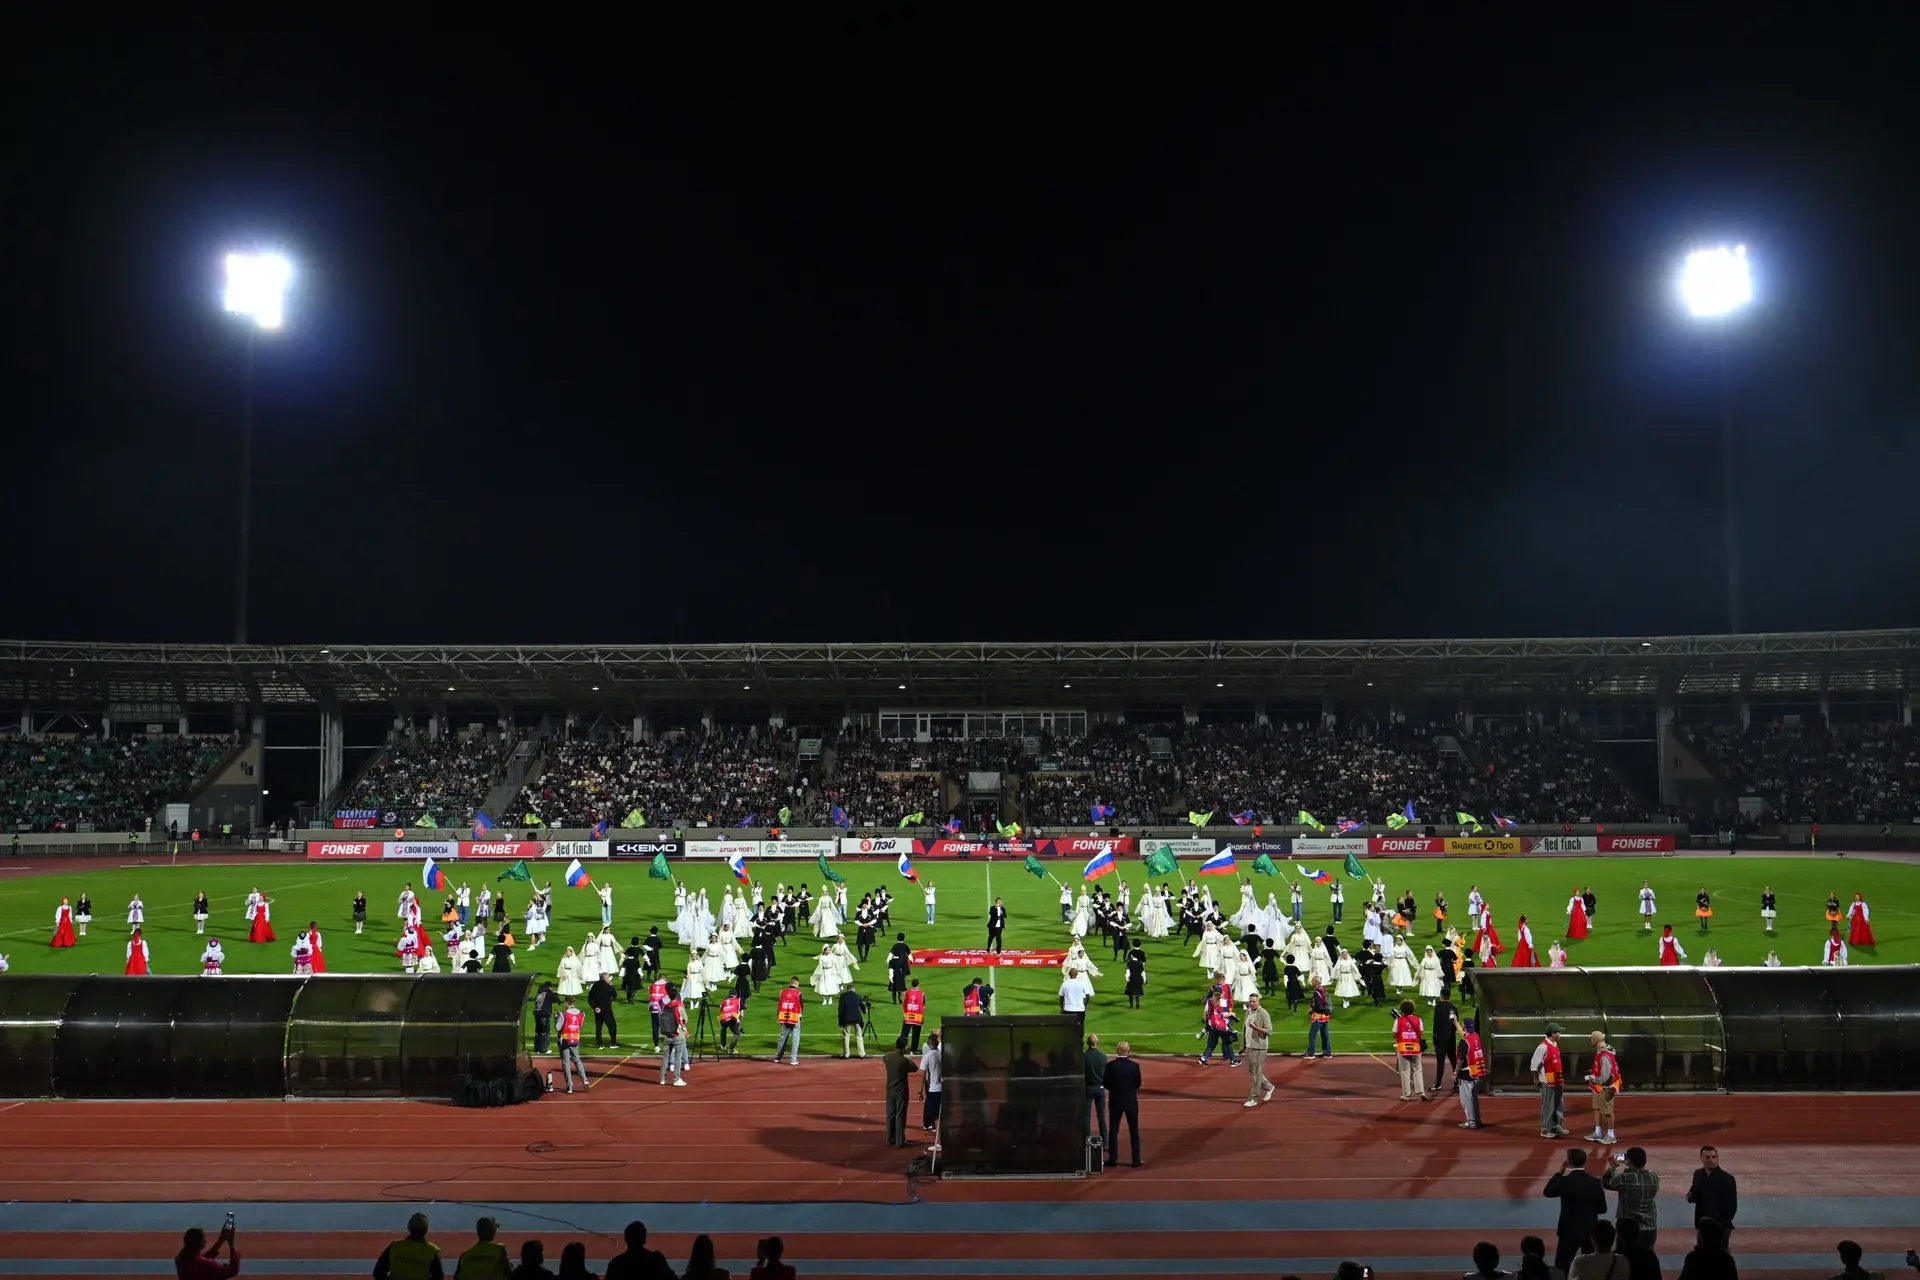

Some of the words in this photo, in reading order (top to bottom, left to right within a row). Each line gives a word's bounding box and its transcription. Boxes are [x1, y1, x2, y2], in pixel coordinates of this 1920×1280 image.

[943, 843, 983, 852] FONBET
[1072, 840, 1121, 850] FONBET
[1261, 842, 1281, 850] Плюс
[1382, 840, 1431, 850] FONBET
[1452, 841, 1483, 850] Яндекс
[1496, 841, 1514, 850] Про
[1544, 837, 1559, 852] Red
[1560, 837, 1581, 850] finch
[1611, 838, 1661, 849] FONBET
[321, 845, 370, 854] FONBET
[404, 846, 422, 854] СВОИ
[423, 846, 448, 854] ПЛЮСЫ
[471, 844, 520, 854] FONBET
[556, 843, 570, 856] Red
[572, 843, 593, 855] finch
